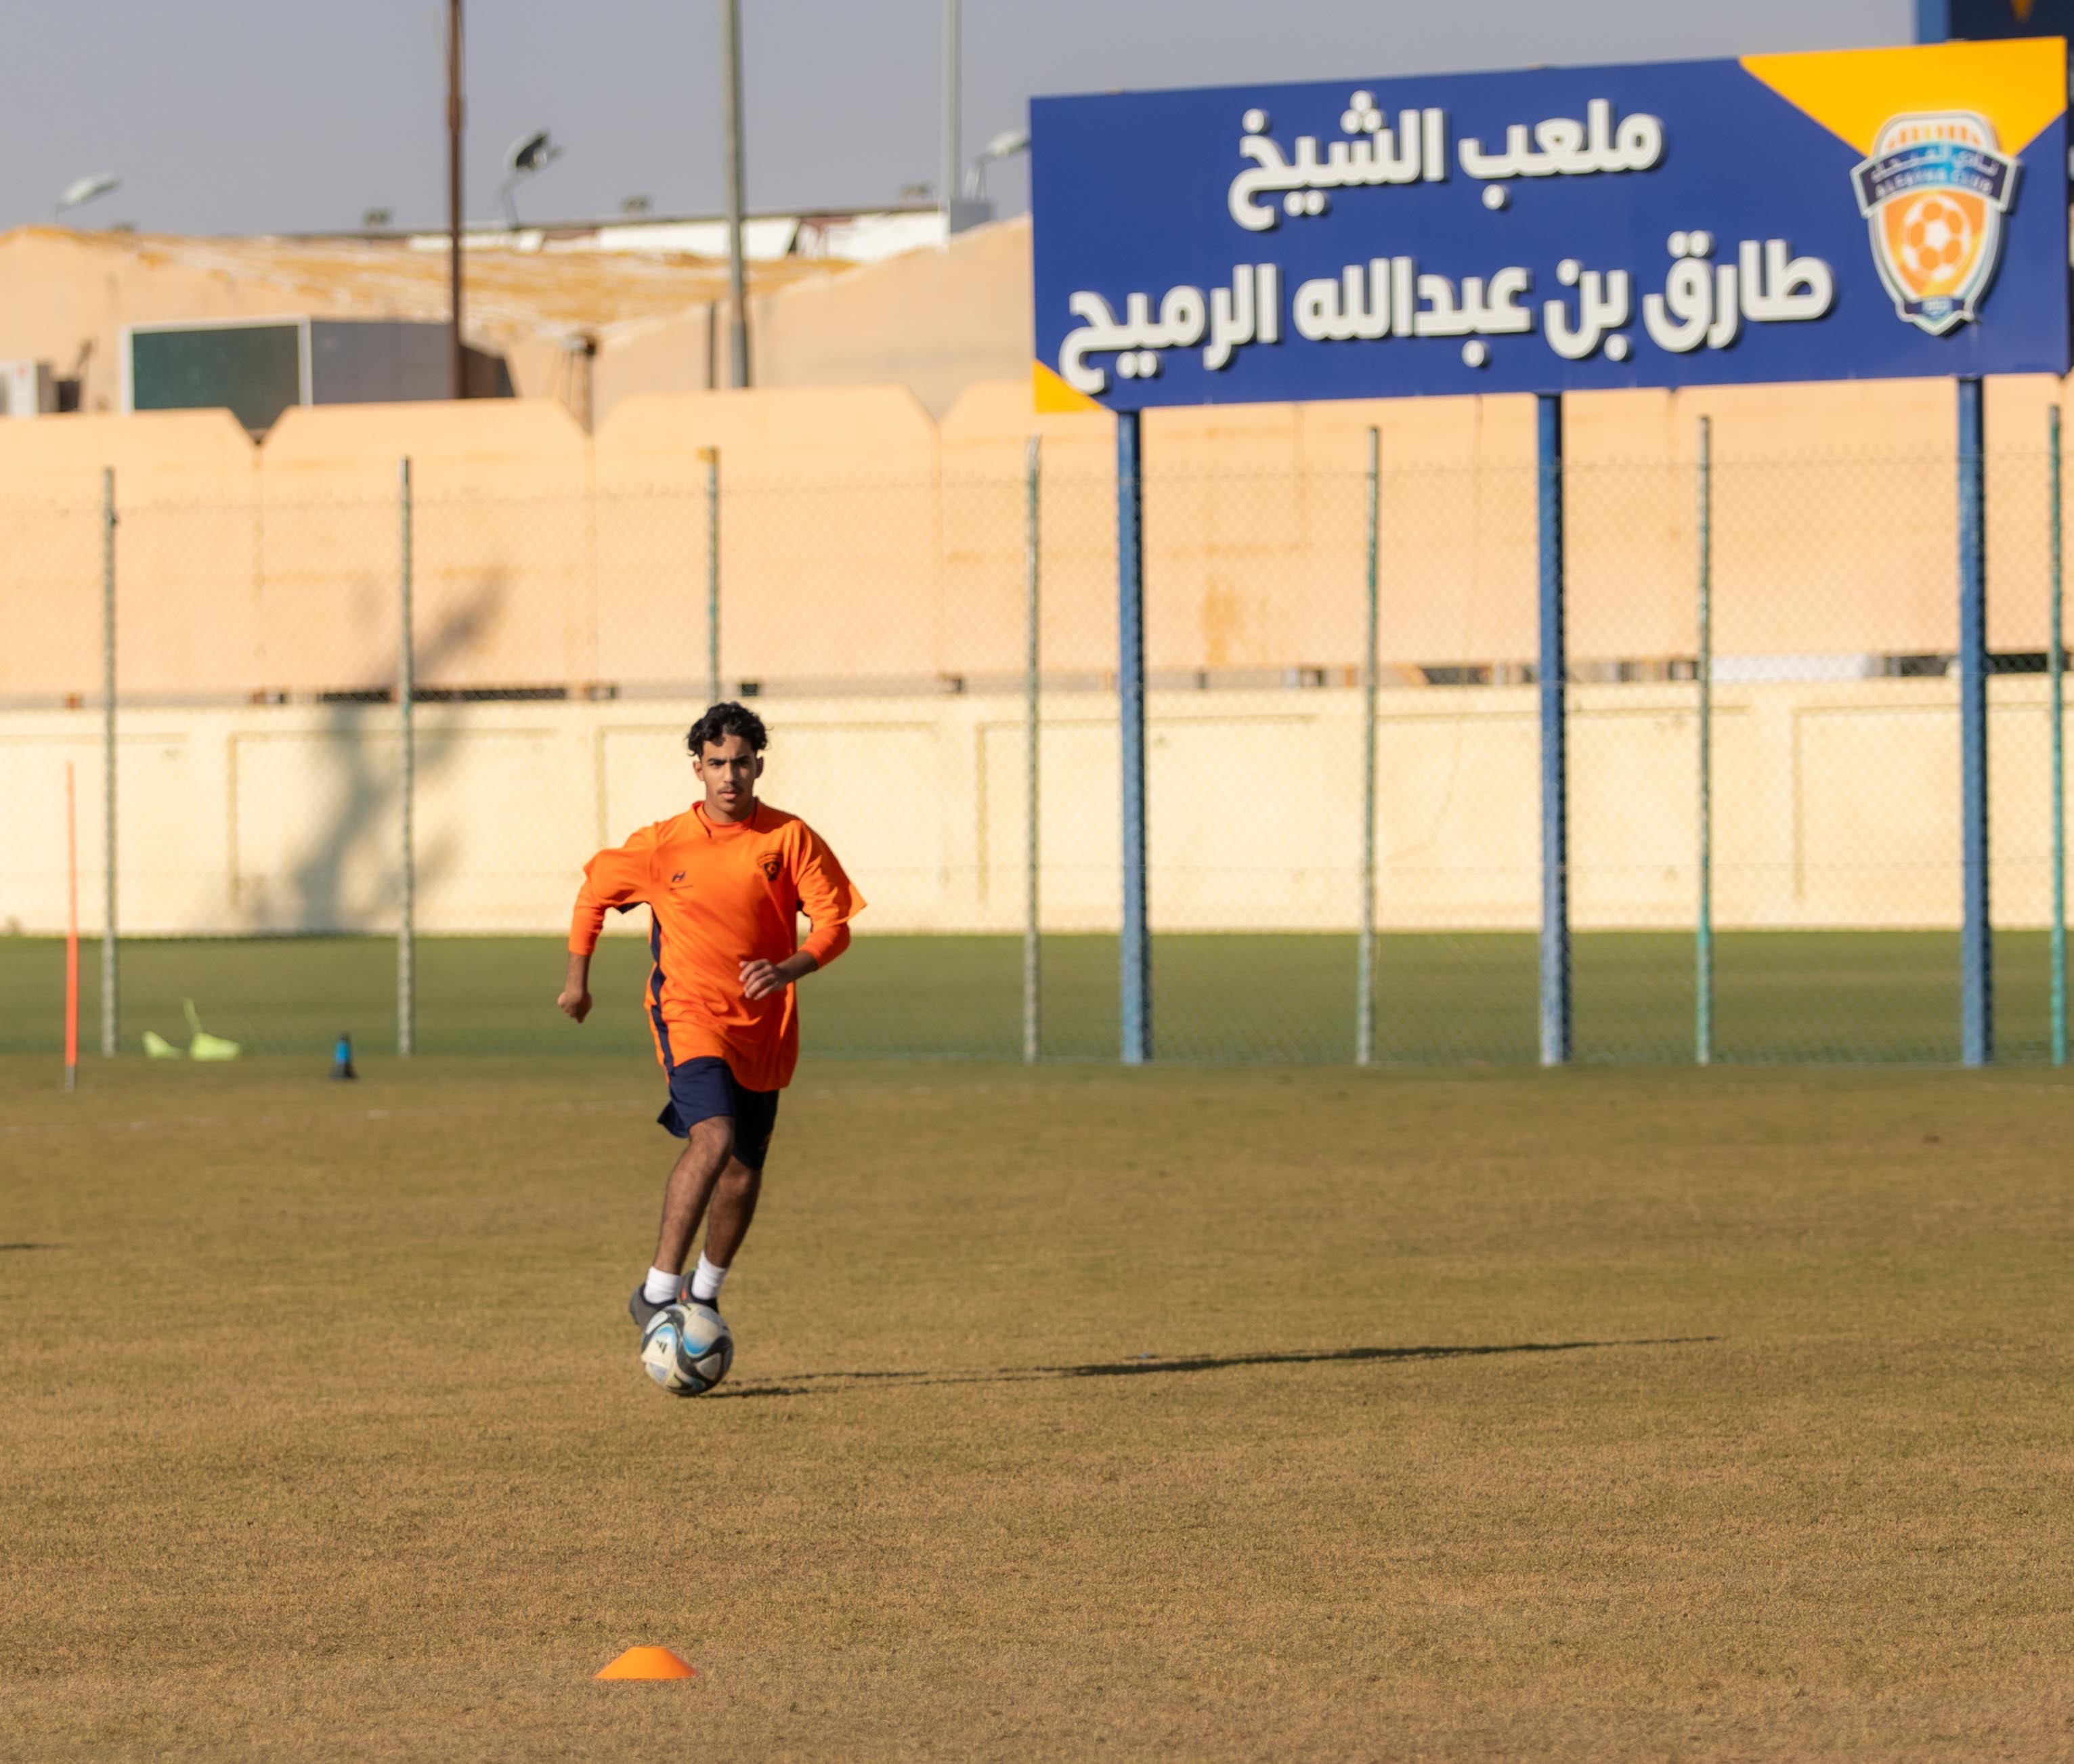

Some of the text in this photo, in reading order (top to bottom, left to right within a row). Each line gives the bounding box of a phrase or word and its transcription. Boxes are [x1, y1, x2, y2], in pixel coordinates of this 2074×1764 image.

[1228, 90, 1663, 231] ملعب الشيخ
[1058, 230, 1834, 394] طارق بن عبدالله الرميح
